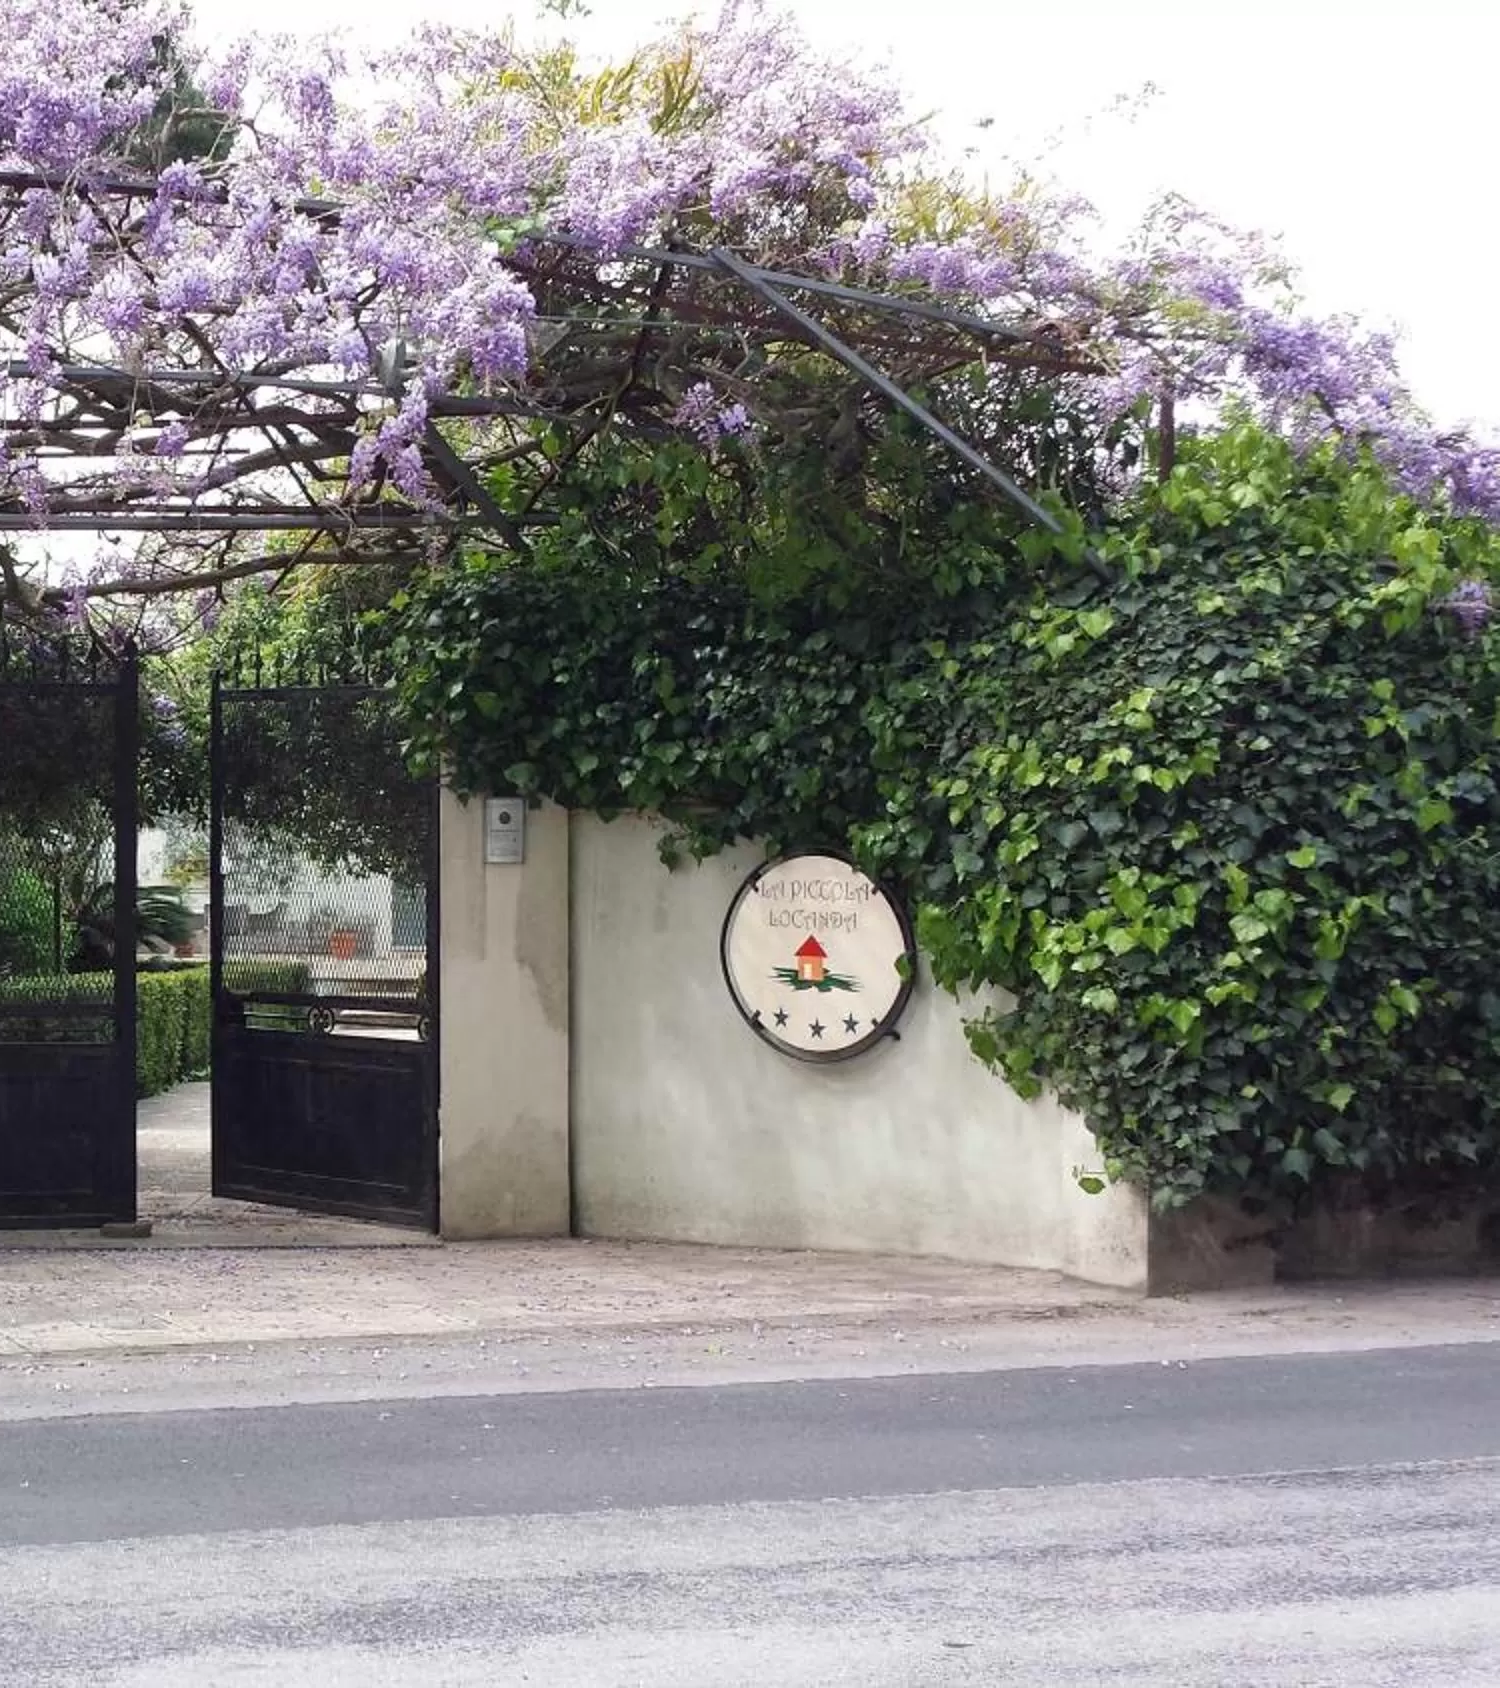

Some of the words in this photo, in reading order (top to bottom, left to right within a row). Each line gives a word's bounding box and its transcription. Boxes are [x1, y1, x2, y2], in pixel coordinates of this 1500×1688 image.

[761, 879, 785, 899] LA
[791, 879, 870, 902] PICCOLA
[769, 909, 858, 931] LOCANDA
